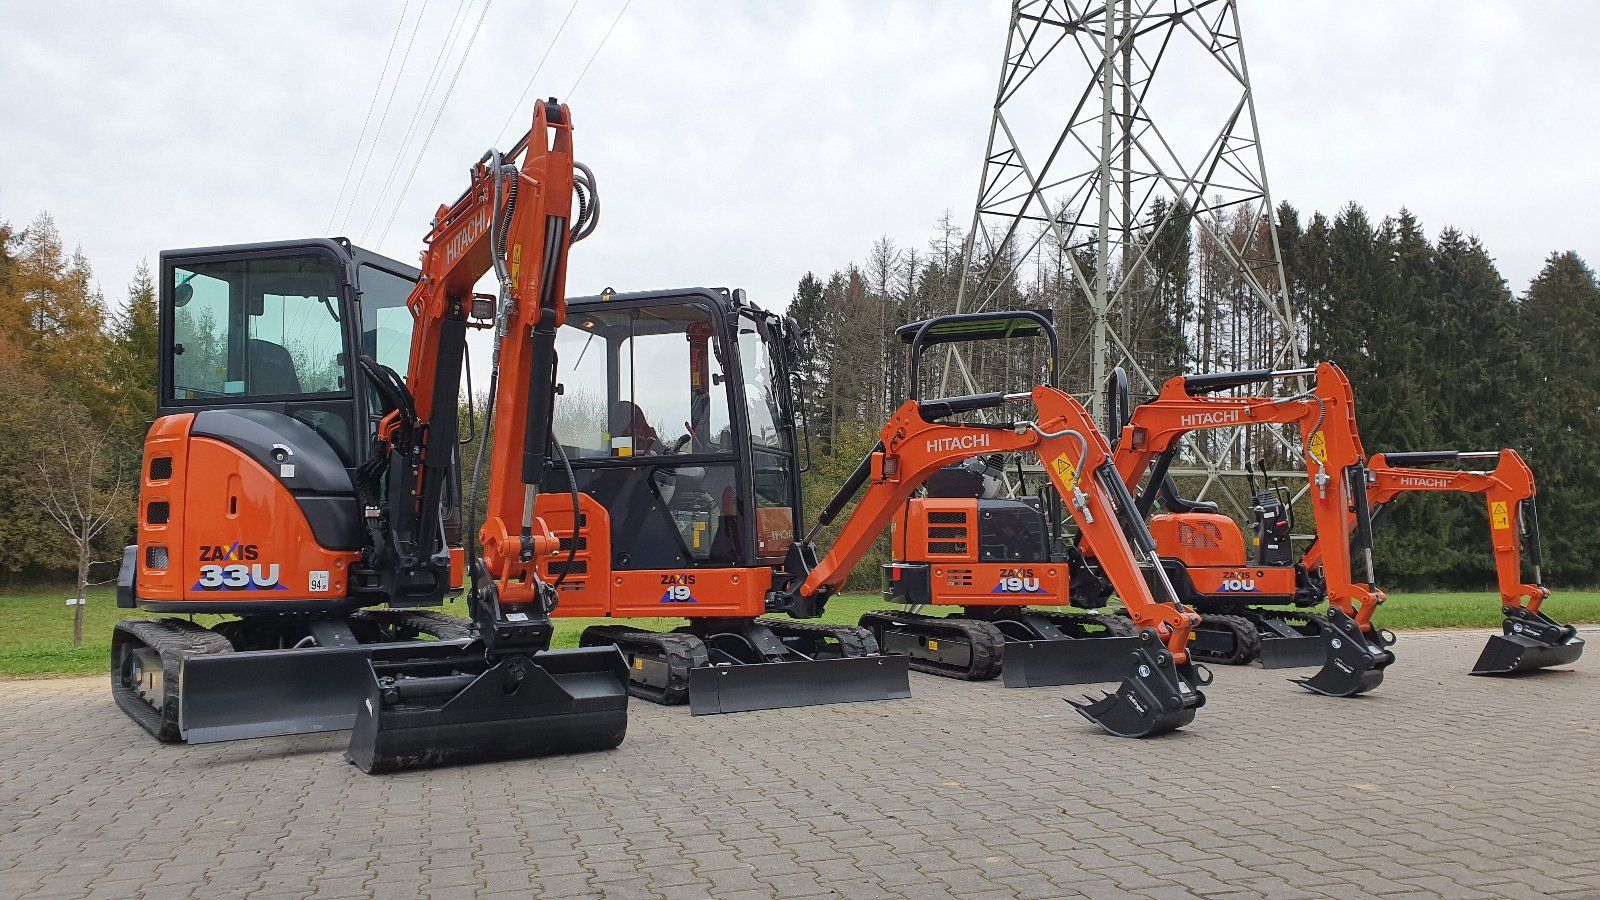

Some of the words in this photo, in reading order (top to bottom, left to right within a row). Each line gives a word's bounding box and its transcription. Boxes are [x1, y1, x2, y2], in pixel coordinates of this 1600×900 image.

[446, 207, 486, 265] HITACHI
[1181, 410, 1238, 426] HITACHI
[926, 434, 990, 452] HITACHI
[1400, 477, 1447, 487] HITACHI
[199, 541, 259, 562] ZAXIS
[199, 563, 280, 590] 33U
[660, 572, 696, 585] ZAXIS
[1000, 566, 1034, 578] ZAXIS
[1223, 570, 1251, 580] ZAXIS
[1000, 577, 1040, 592] 19U
[1222, 579, 1255, 592] 10U
[667, 585, 691, 601] 19
